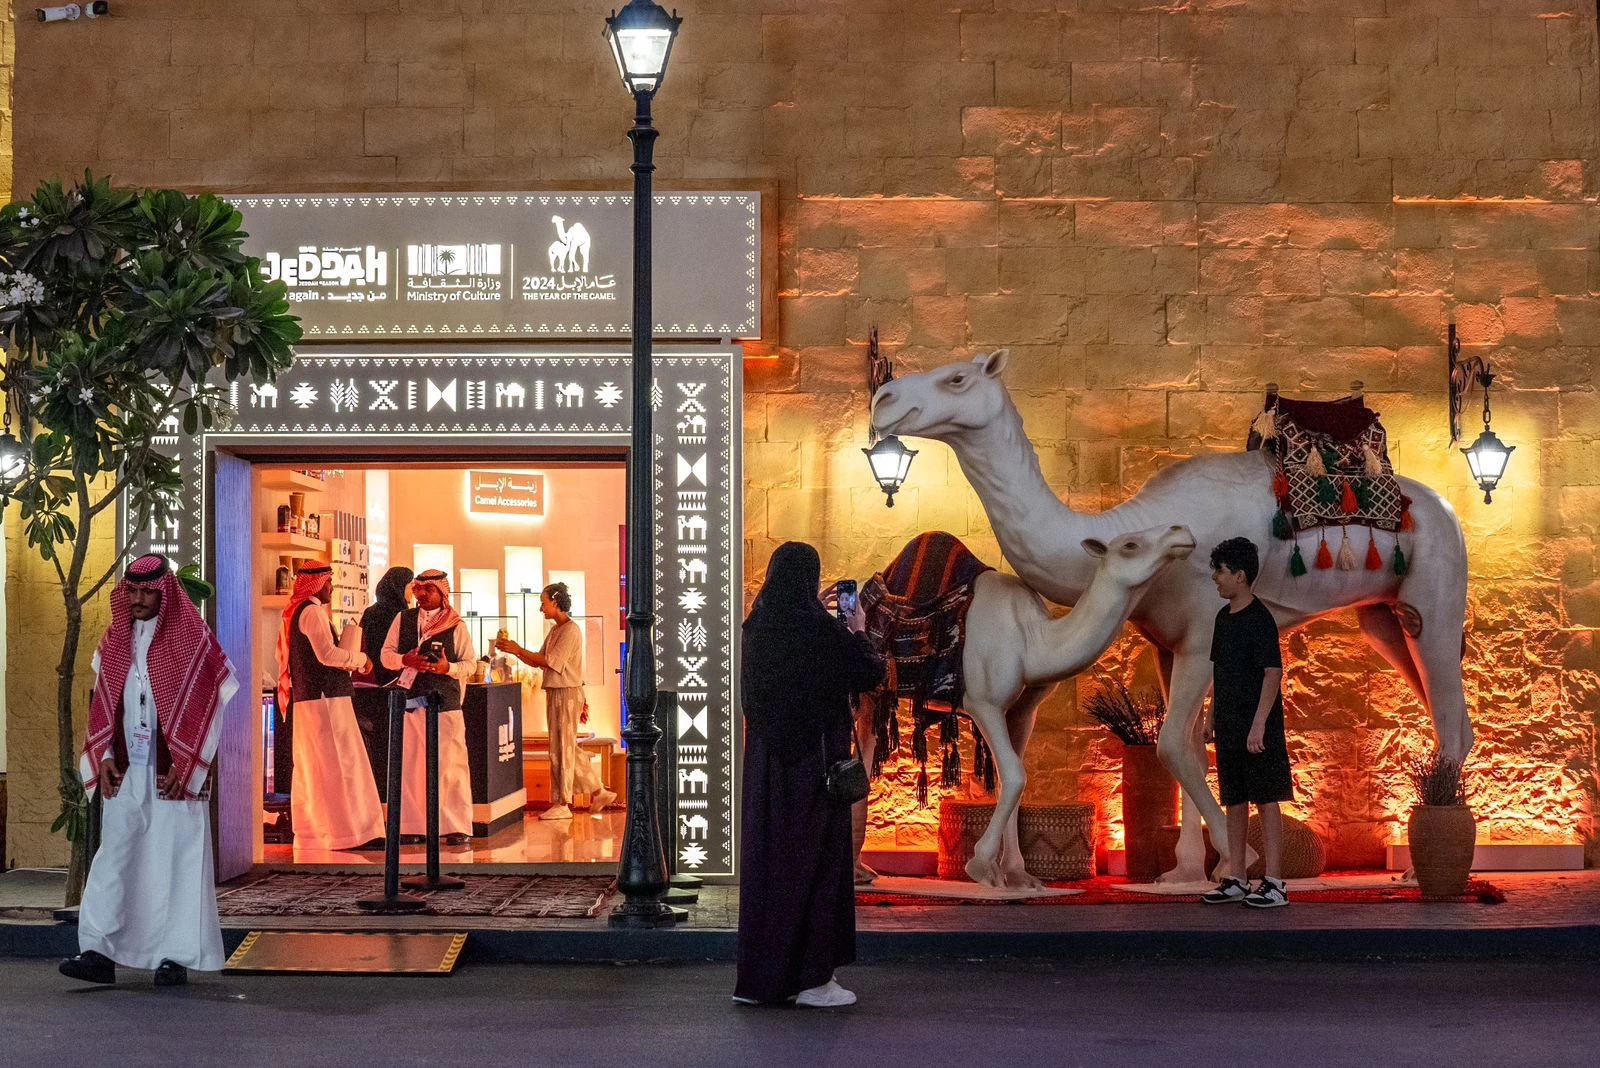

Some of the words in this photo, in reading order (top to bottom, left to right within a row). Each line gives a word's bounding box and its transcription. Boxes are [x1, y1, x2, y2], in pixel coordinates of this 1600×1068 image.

[407, 277, 475, 289] الثقافة
[477, 277, 501, 290] وزارة
[522, 276, 556, 290] 2024
[556, 275, 586, 292] الإبل
[289, 290, 319, 302] again
[327, 291, 365, 303] جديد
[366, 291, 387, 301] من
[407, 291, 448, 303] Ministry
[449, 290, 461, 301] of
[462, 290, 501, 301] Culture
[522, 292, 539, 300] THE
[540, 292, 560, 300] YEAR
[561, 292, 572, 300] OF
[573, 292, 588, 300] THE
[589, 292, 616, 300] CAMEL
[474, 475, 507, 493] الإبل
[507, 476, 537, 494] زينة
[474, 494, 497, 506] Camel
[497, 495, 538, 508] Accessories
